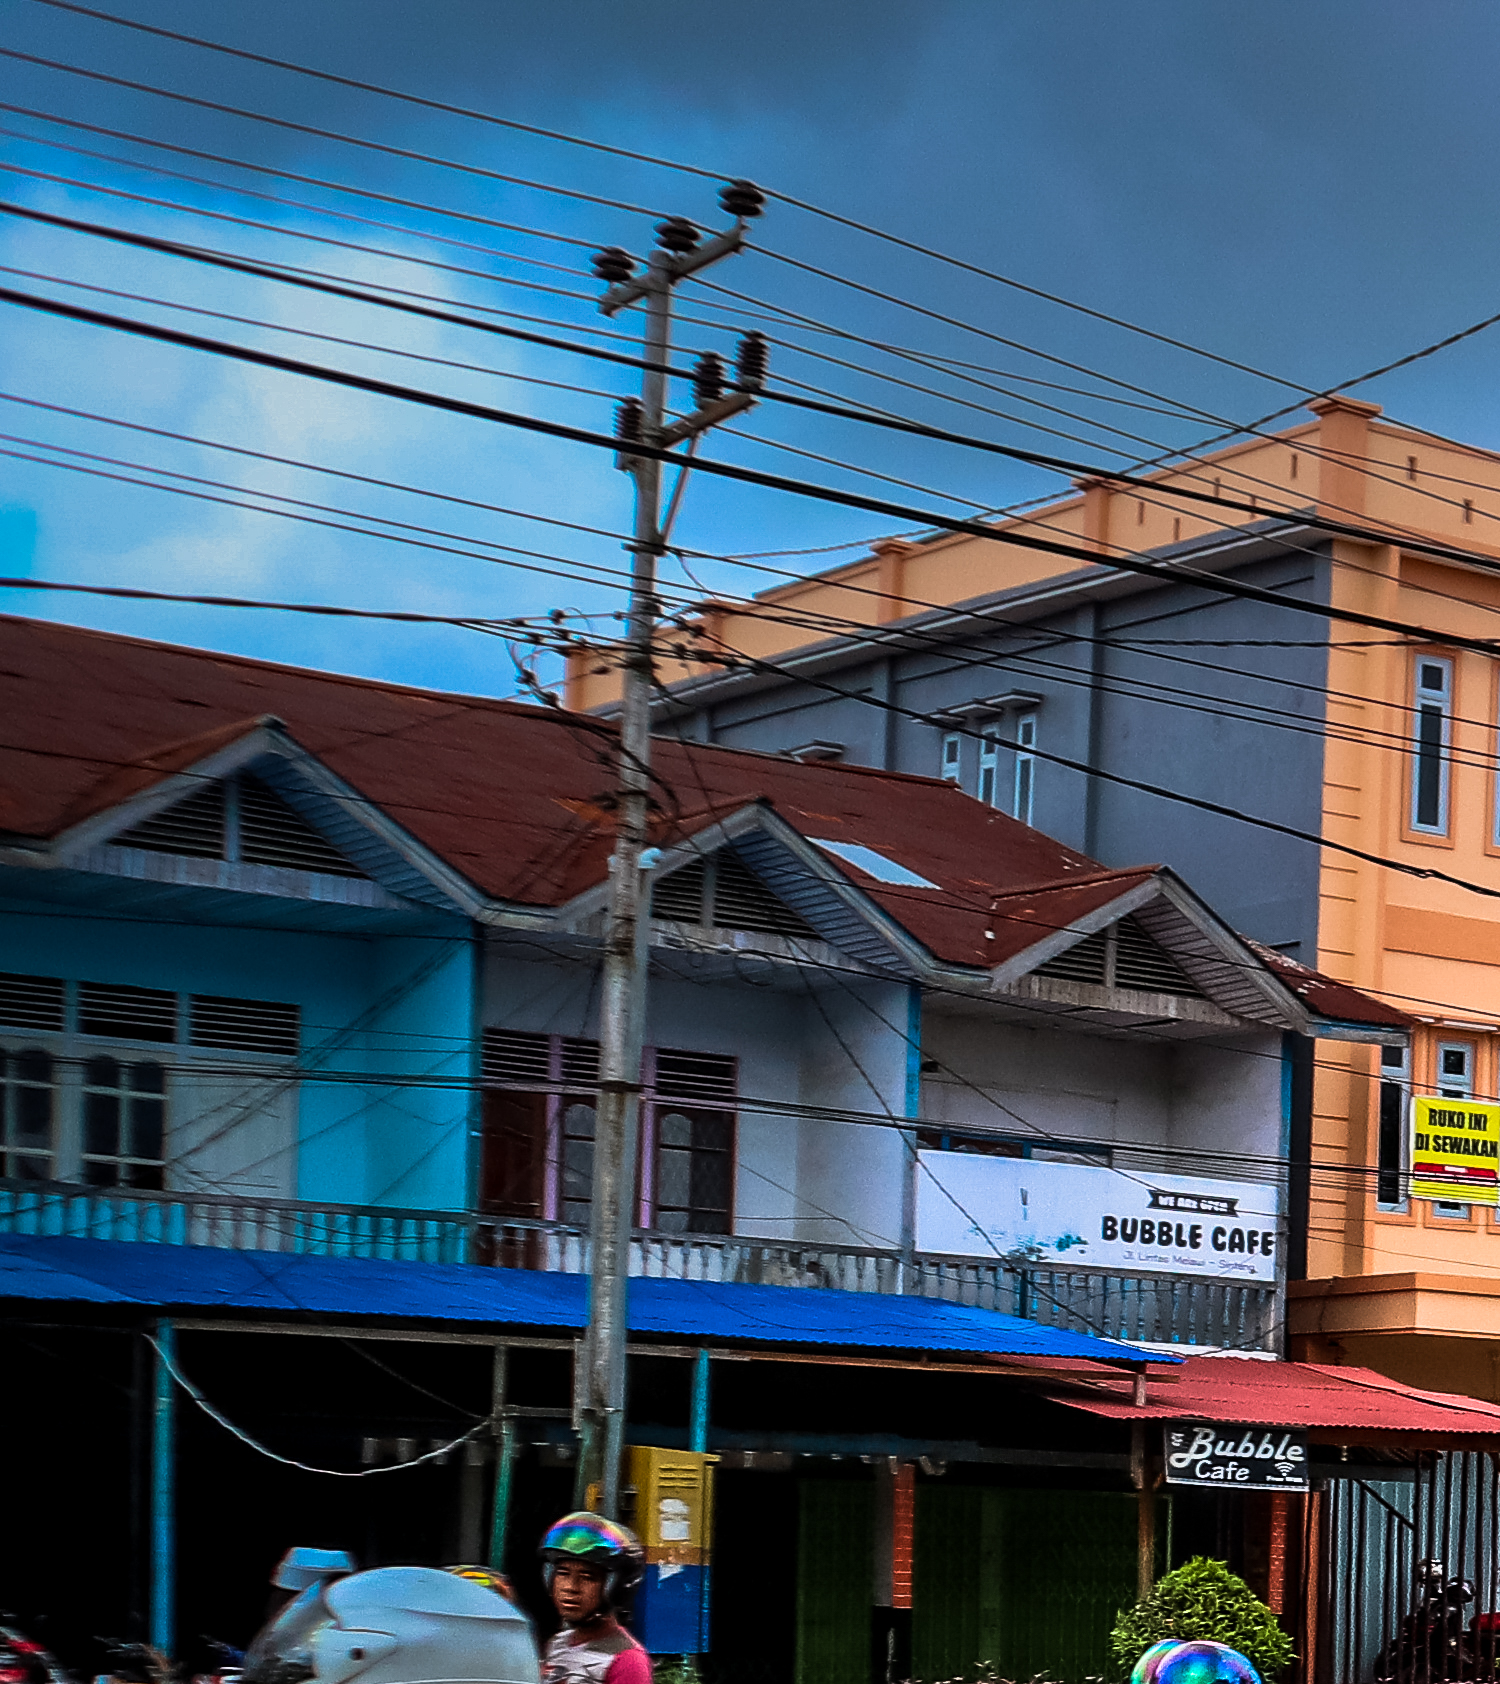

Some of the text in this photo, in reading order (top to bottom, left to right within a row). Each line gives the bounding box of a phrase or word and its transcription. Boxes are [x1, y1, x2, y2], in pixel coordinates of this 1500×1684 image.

[1428, 1108, 1488, 1131] RUKO INI
[1415, 1133, 1498, 1158] DI SEWAKAN
[1101, 1215, 1276, 1256] BUBBLE CAFE
[1169, 1427, 1304, 1468] Bubble
[1195, 1460, 1250, 1481] Cafe
